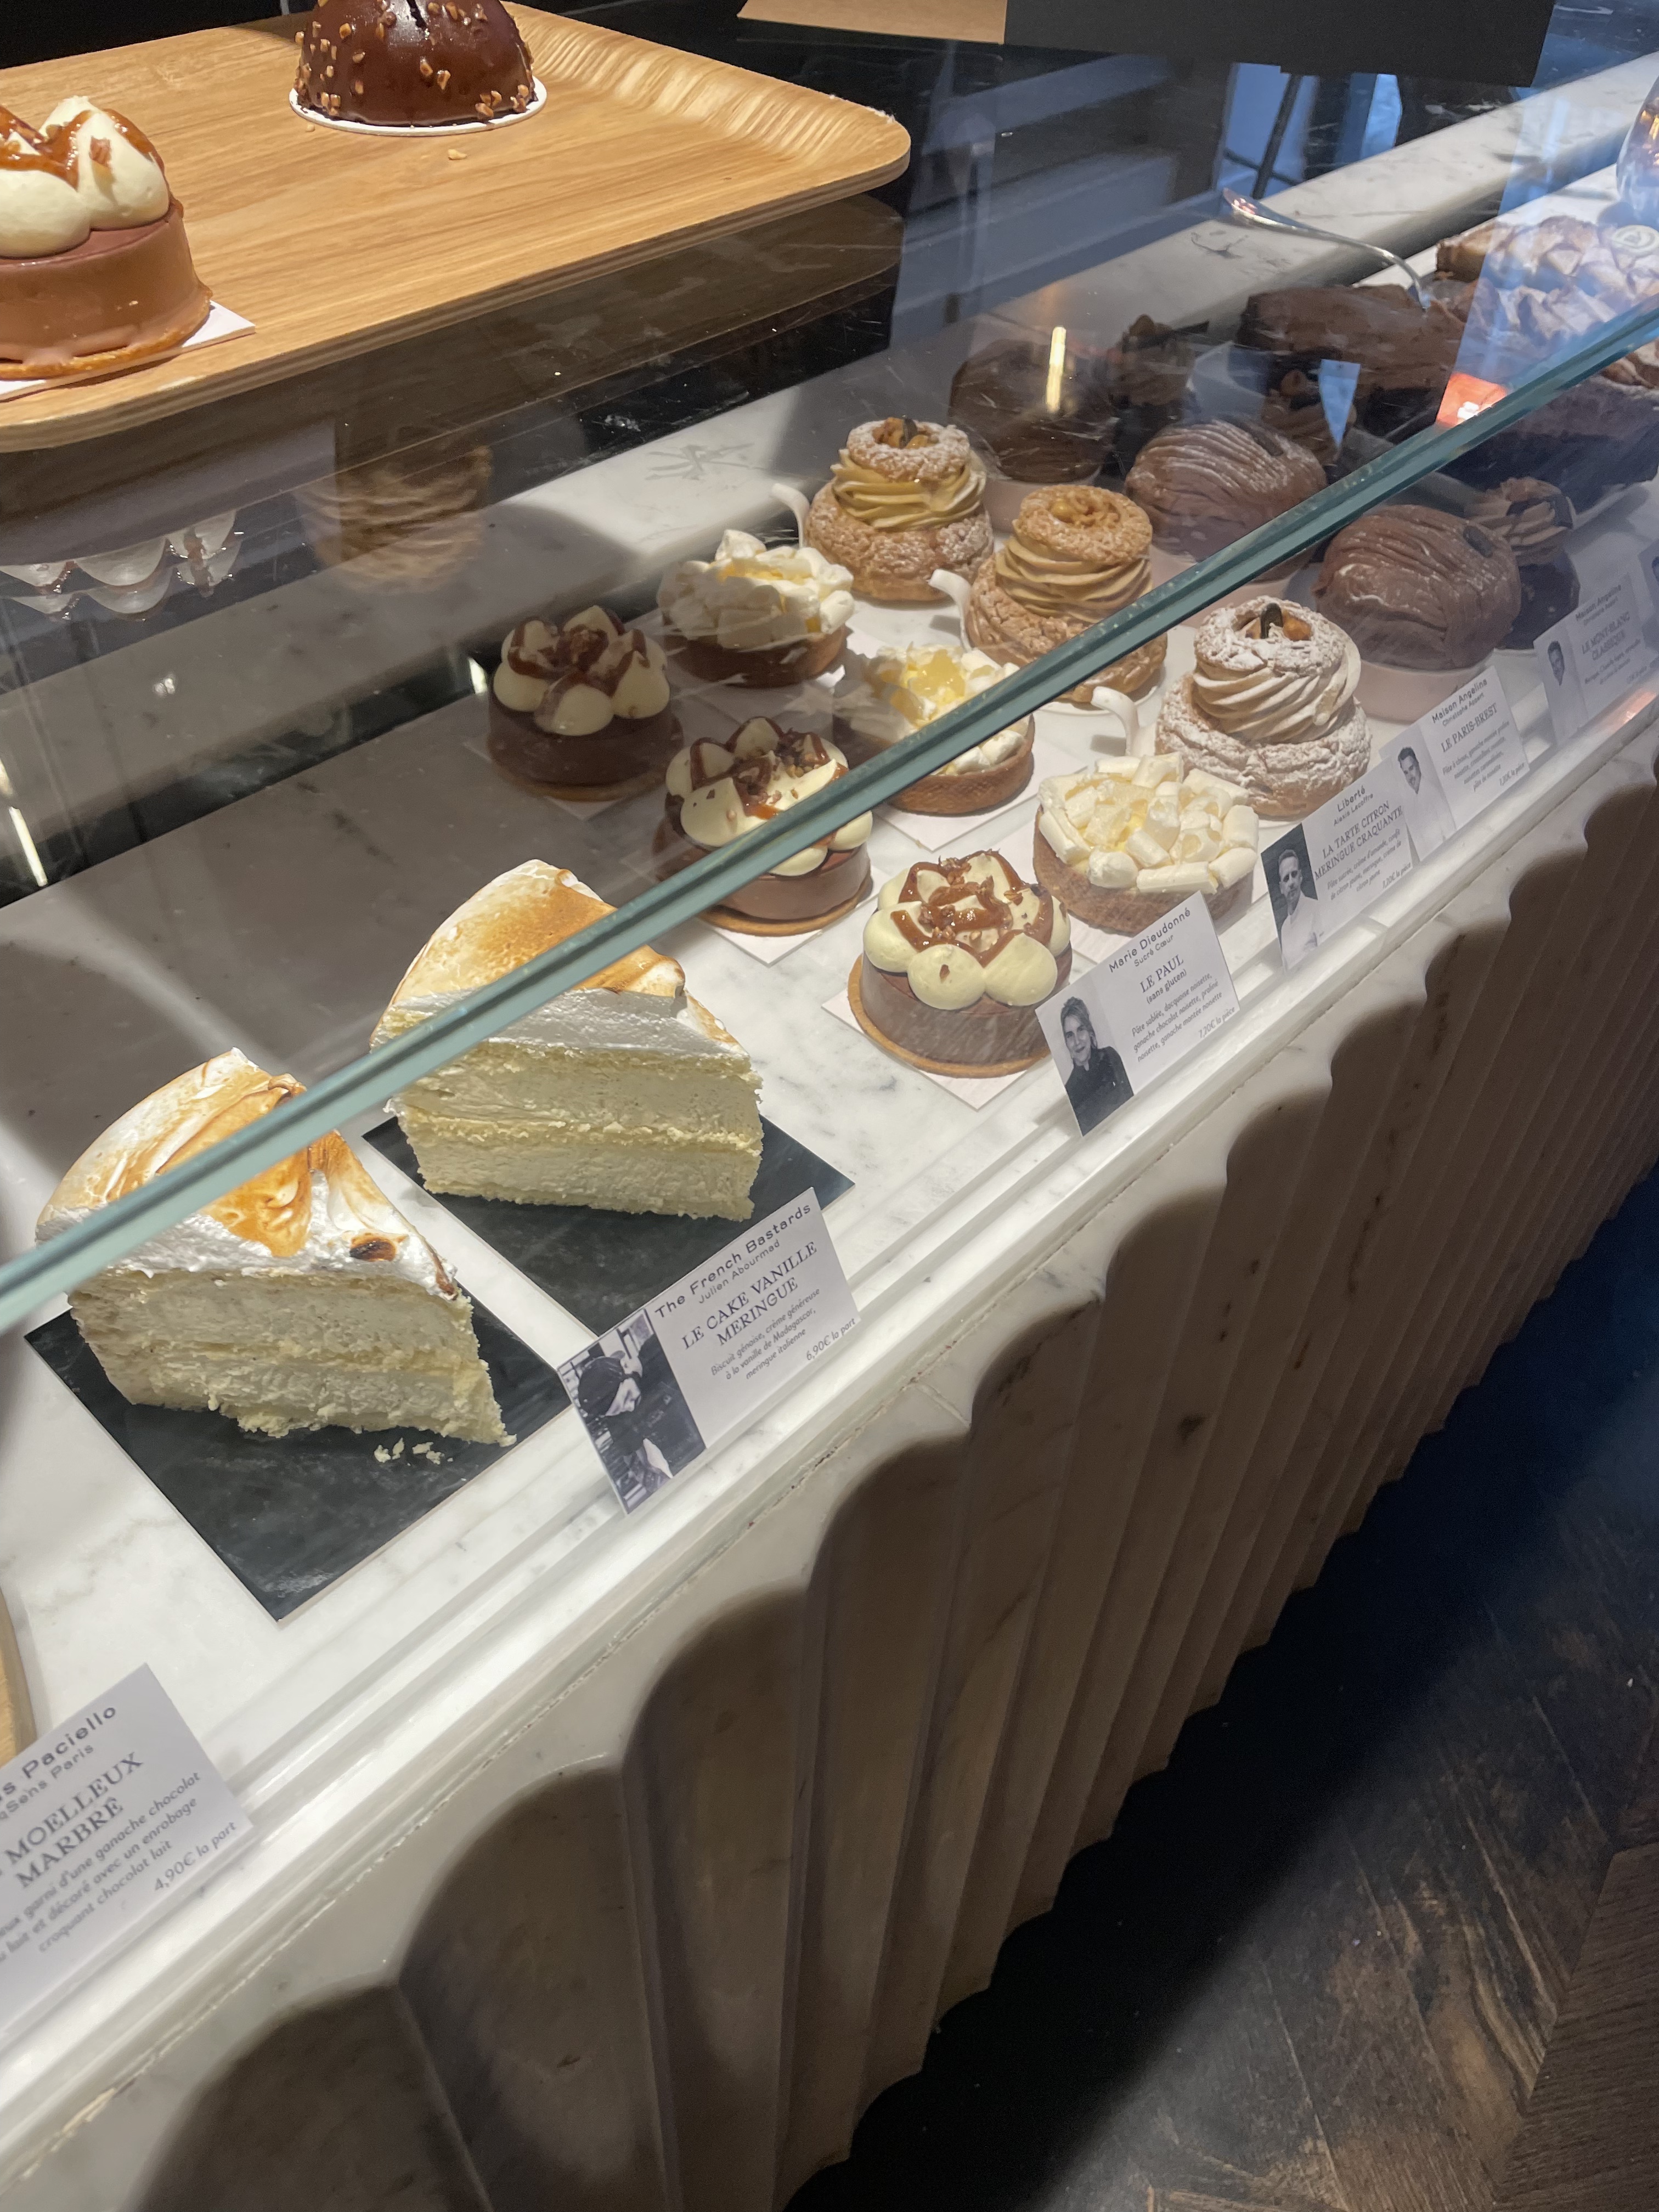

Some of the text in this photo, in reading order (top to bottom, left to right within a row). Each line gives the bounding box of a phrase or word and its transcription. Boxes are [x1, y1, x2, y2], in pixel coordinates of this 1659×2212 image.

[1432, 702, 1457, 723] Maison
[1441, 738, 1452, 752] LE
[1452, 702, 1497, 744] PARIS-BREST
[1314, 805, 1402, 880] MERINGUE CRAQUANTE
[1322, 800, 1389, 859] LA TARTE CITRON
[1108, 907, 1190, 973] Marie Dieudonné
[1133, 934, 1173, 967] Sucré Cœur
[1139, 954, 1184, 993] LE PAUL
[1146, 968, 1187, 1005] (sans gluten)
[1131, 1023, 1145, 1037] Pâte
[1133, 1030, 1155, 1053] ganache
[1155, 1011, 1178, 1033] chocolat
[1160, 1023, 1182, 1046] ganache
[654, 1205, 810, 1318] The French Bastards
[698, 1238, 780, 1304] Julien Abourmad
[681, 1241, 817, 1349] LE CAKE VANILLE
[716, 1277, 798, 1345] MERINGUE
[710, 1288, 820, 1376] Biscuit génoise, crème généreuse
[725, 1307, 816, 1380] à la vanille de Madagascar,
[746, 1328, 806, 1379] meringue italienne
[805, 1317, 855, 1361] 6,90€ la part
[21, 1707, 116, 1779] Paciello
[50, 1745, 94, 1779] Paris
[4, 1751, 143, 1865] MOELLEUX
[59, 1858, 92, 1888] d'une
[94, 1815, 146, 1861] ganache
[148, 1772, 200, 1816] chocolat
[93, 1859, 121, 1884] avec
[123, 1843, 140, 1859] un
[142, 1798, 196, 1844] enrobage
[97, 1858, 150, 1904] chocolat
[149, 1840, 171, 1860] lait
[153, 1821, 236, 1891] 4,90€ la part
